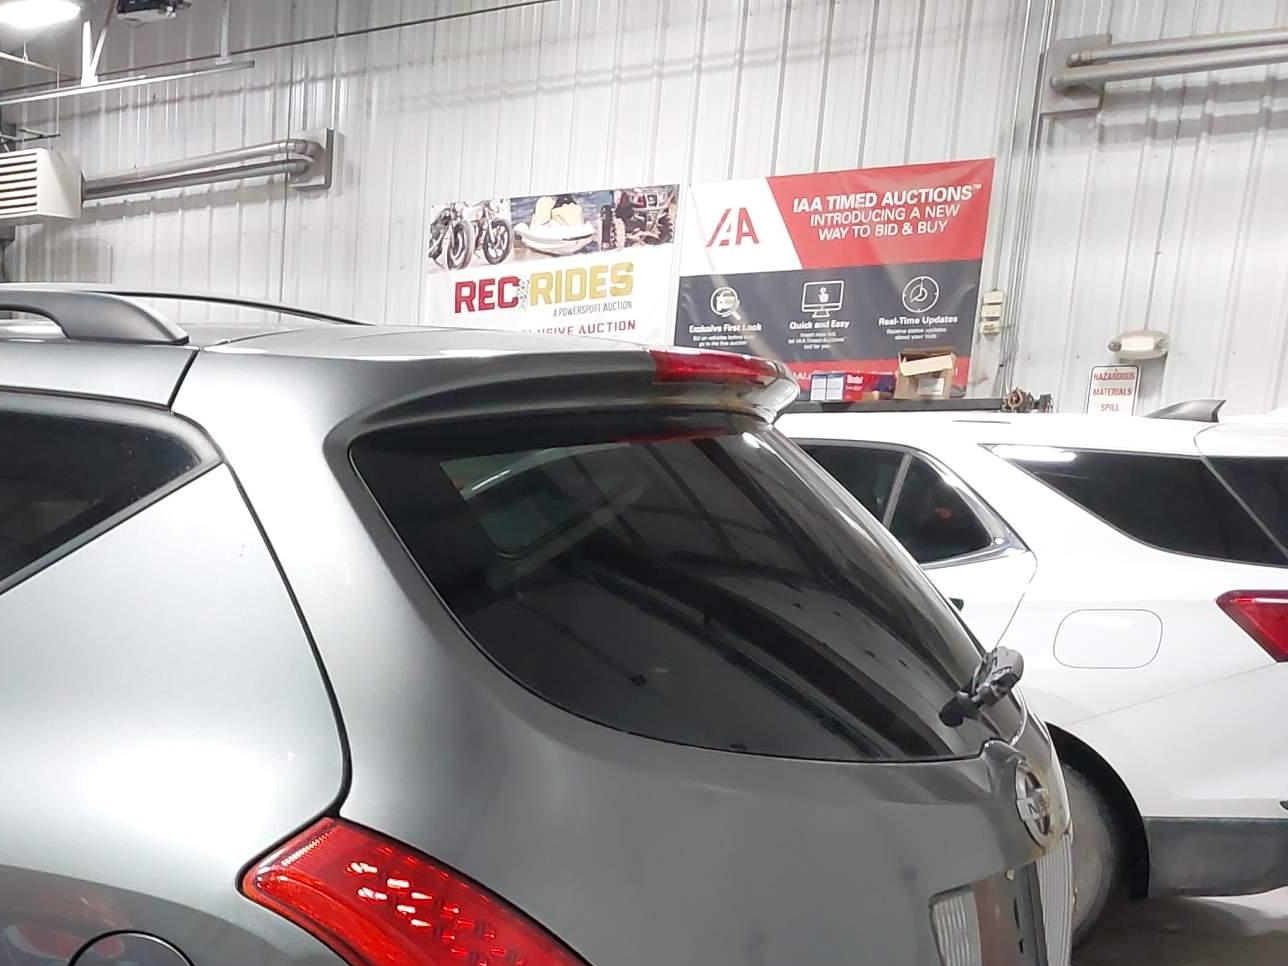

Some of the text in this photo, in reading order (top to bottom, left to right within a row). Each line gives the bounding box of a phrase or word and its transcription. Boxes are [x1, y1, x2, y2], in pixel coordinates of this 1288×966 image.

[793, 197, 822, 213] IAA
[826, 192, 877, 210] TIMED
[810, 204, 960, 226] INTRODUCING A NEW
[818, 219, 948, 241] WAY TO BID & BUY
[454, 262, 634, 314] REC RIDES
[558, 303, 601, 317] POWERSPORT
[602, 301, 632, 312] AUCTION
[578, 319, 636, 335] AUCTION
[789, 319, 850, 330] Quick and Easy
[878, 315, 958, 326] Real-Time Updates
[1092, 388, 1132, 396] MATERIALS
[1100, 403, 1120, 412] SPILL
